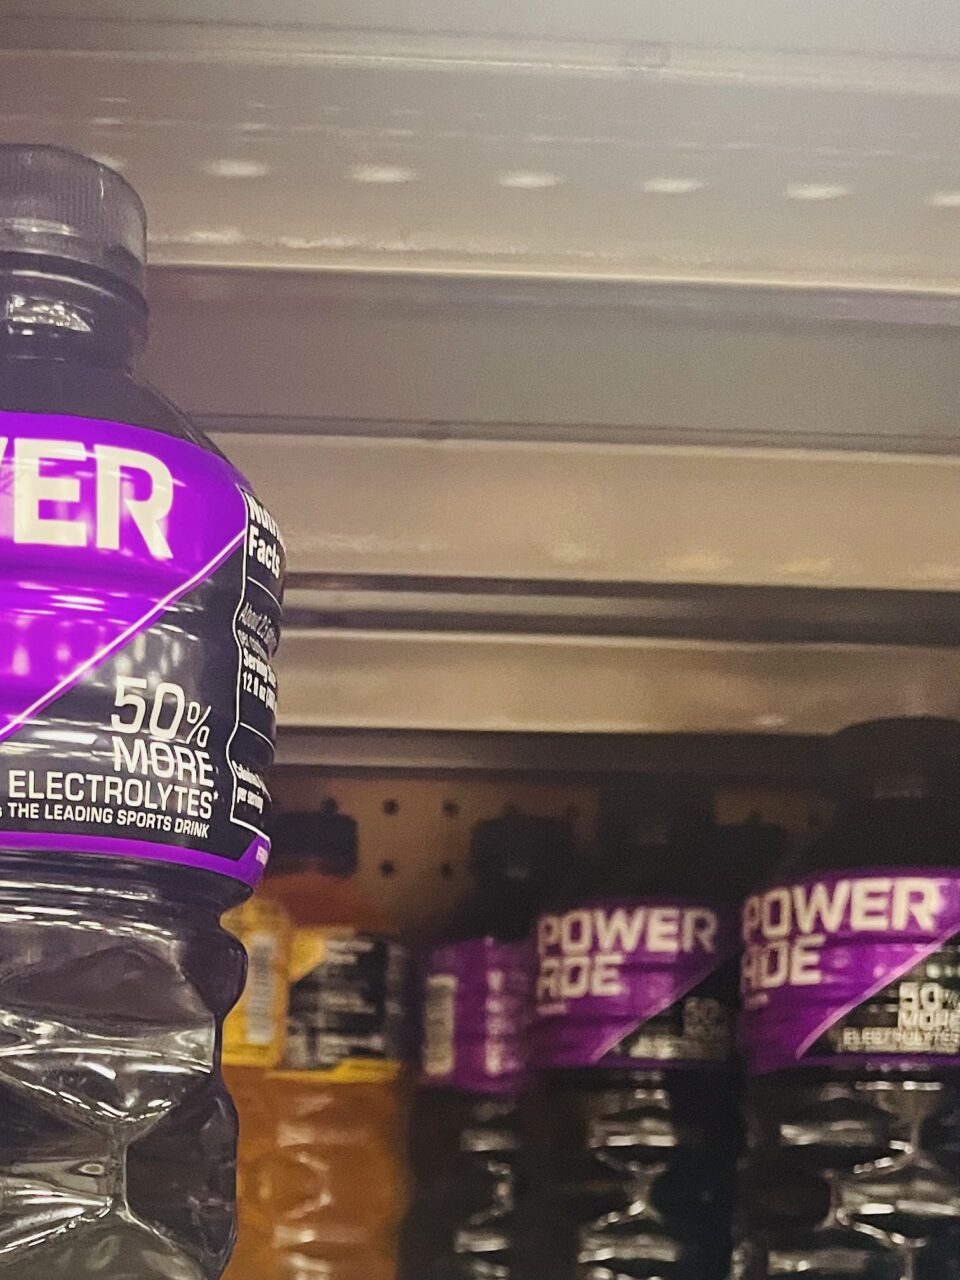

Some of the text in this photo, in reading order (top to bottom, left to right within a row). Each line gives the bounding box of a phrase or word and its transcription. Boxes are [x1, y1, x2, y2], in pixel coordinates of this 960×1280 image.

[248, 525, 280, 579] Facts
[111, 675, 212, 748] 50%
[112, 736, 215, 787] MORE
[8, 802, 39, 819] THE
[45, 803, 113, 824] LEADING
[116, 811, 171, 832] SPORTS
[174, 818, 210, 839] DRINK
[538, 906, 718, 955] POWER
[743, 878, 939, 941] POWER
